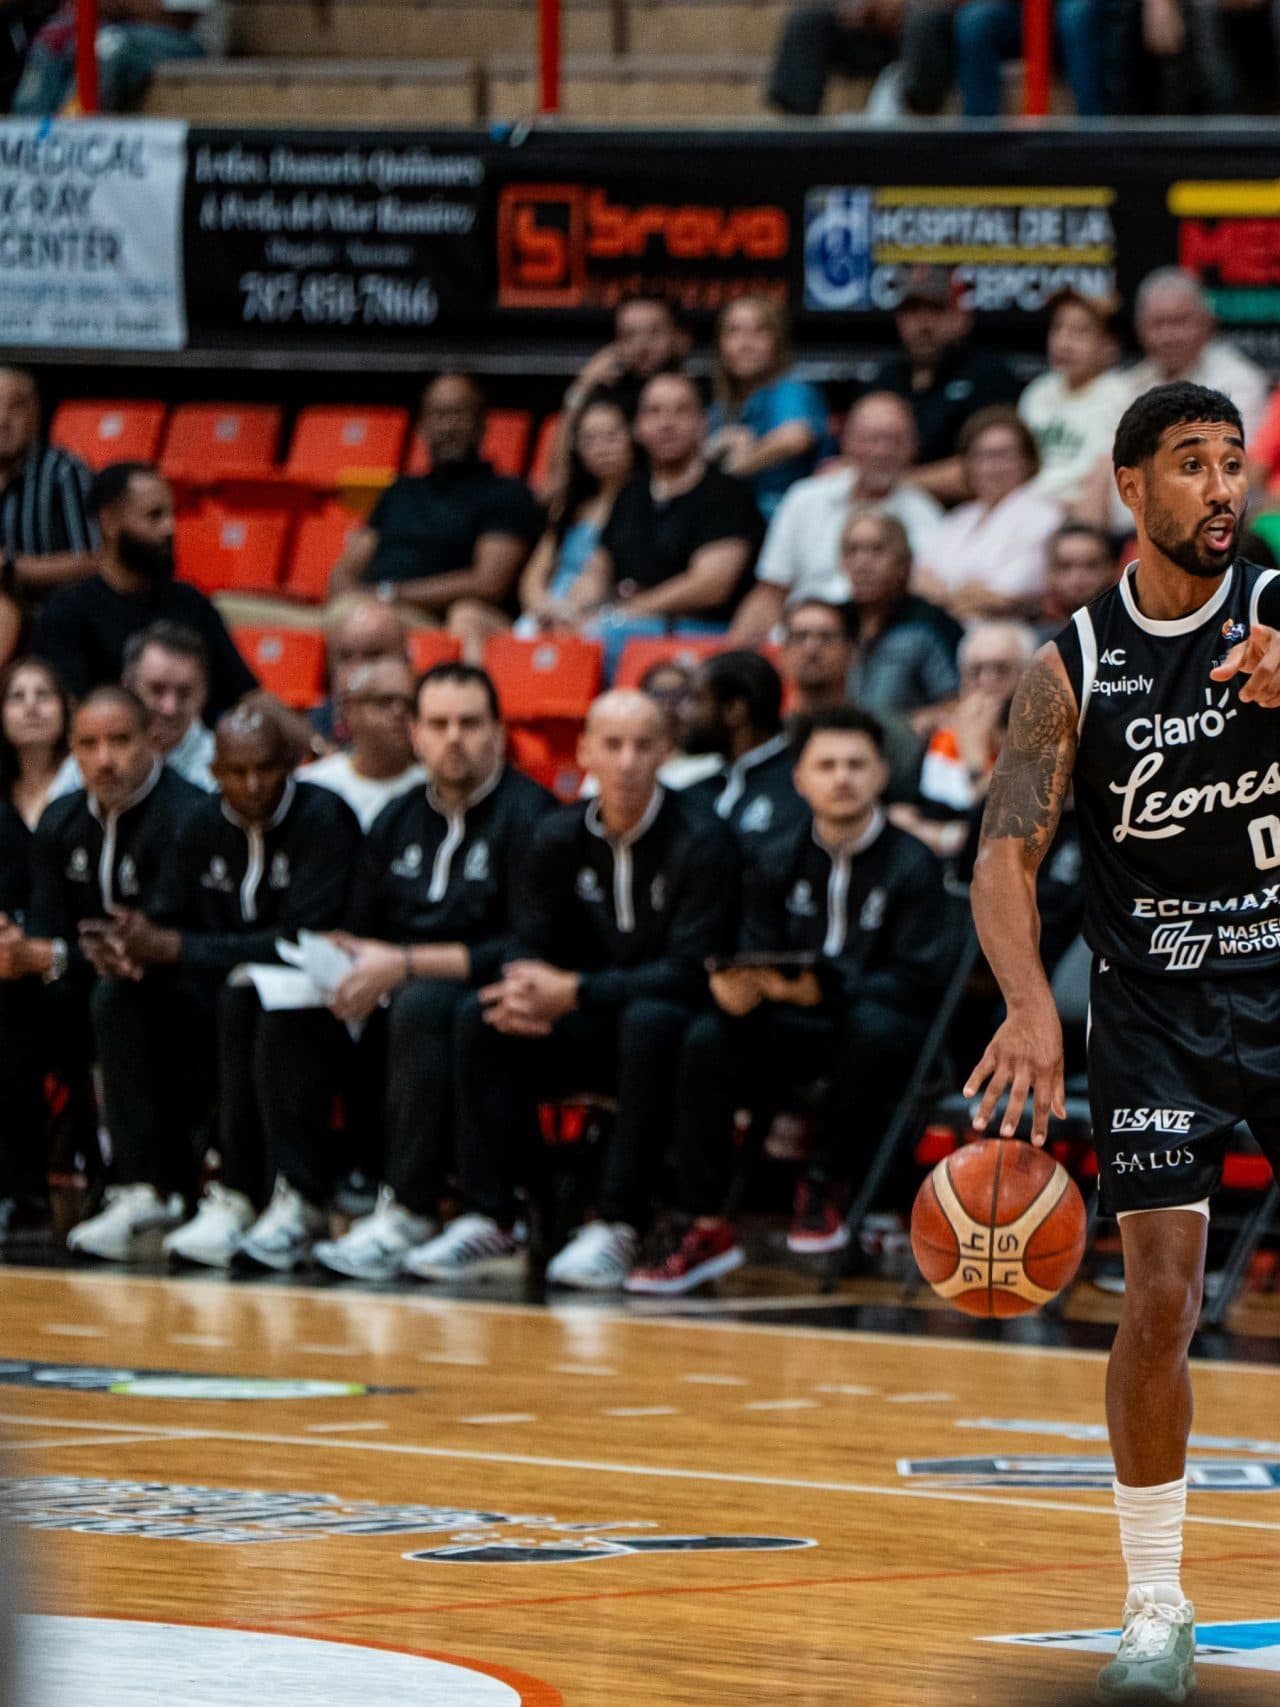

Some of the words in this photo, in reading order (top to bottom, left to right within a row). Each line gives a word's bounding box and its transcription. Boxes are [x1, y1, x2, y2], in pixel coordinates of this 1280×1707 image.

[586, 188, 789, 257] brava
[1017, 206, 1062, 246] DE
[1064, 206, 1115, 247] LA
[1091, 675, 1154, 696] equiply
[1125, 709, 1226, 751] Claro
[1111, 1108, 1195, 1132] U-SAVE
[1112, 1146, 1195, 1174] SALUS
